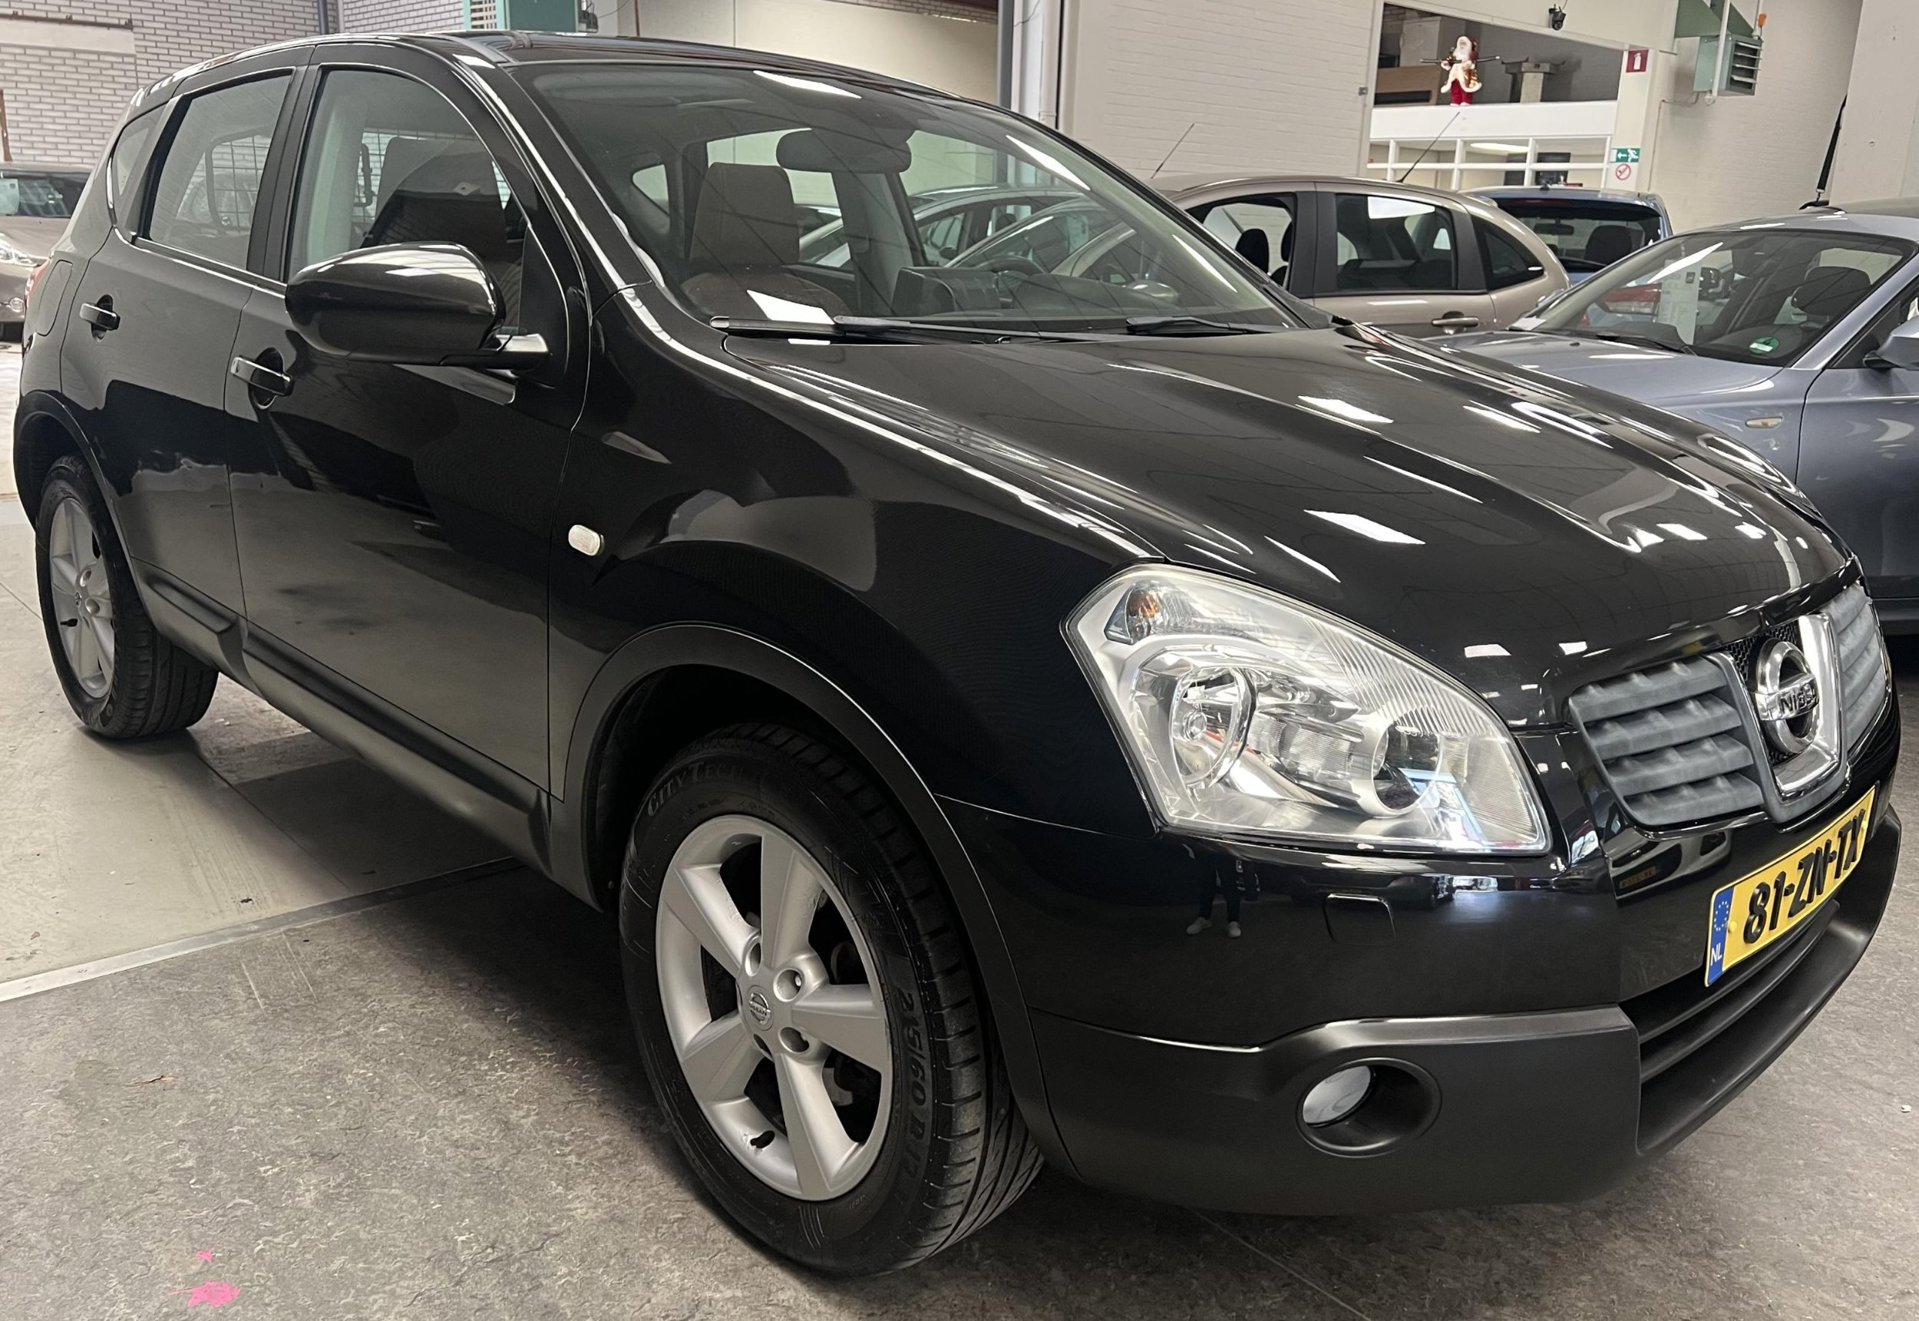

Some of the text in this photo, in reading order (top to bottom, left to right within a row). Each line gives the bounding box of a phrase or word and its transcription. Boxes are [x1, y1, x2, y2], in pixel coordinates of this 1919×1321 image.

[1779, 681, 1817, 714] NISS
[1743, 808, 1867, 944] 81-ZN-TX
[1710, 942, 1722, 966] NL
